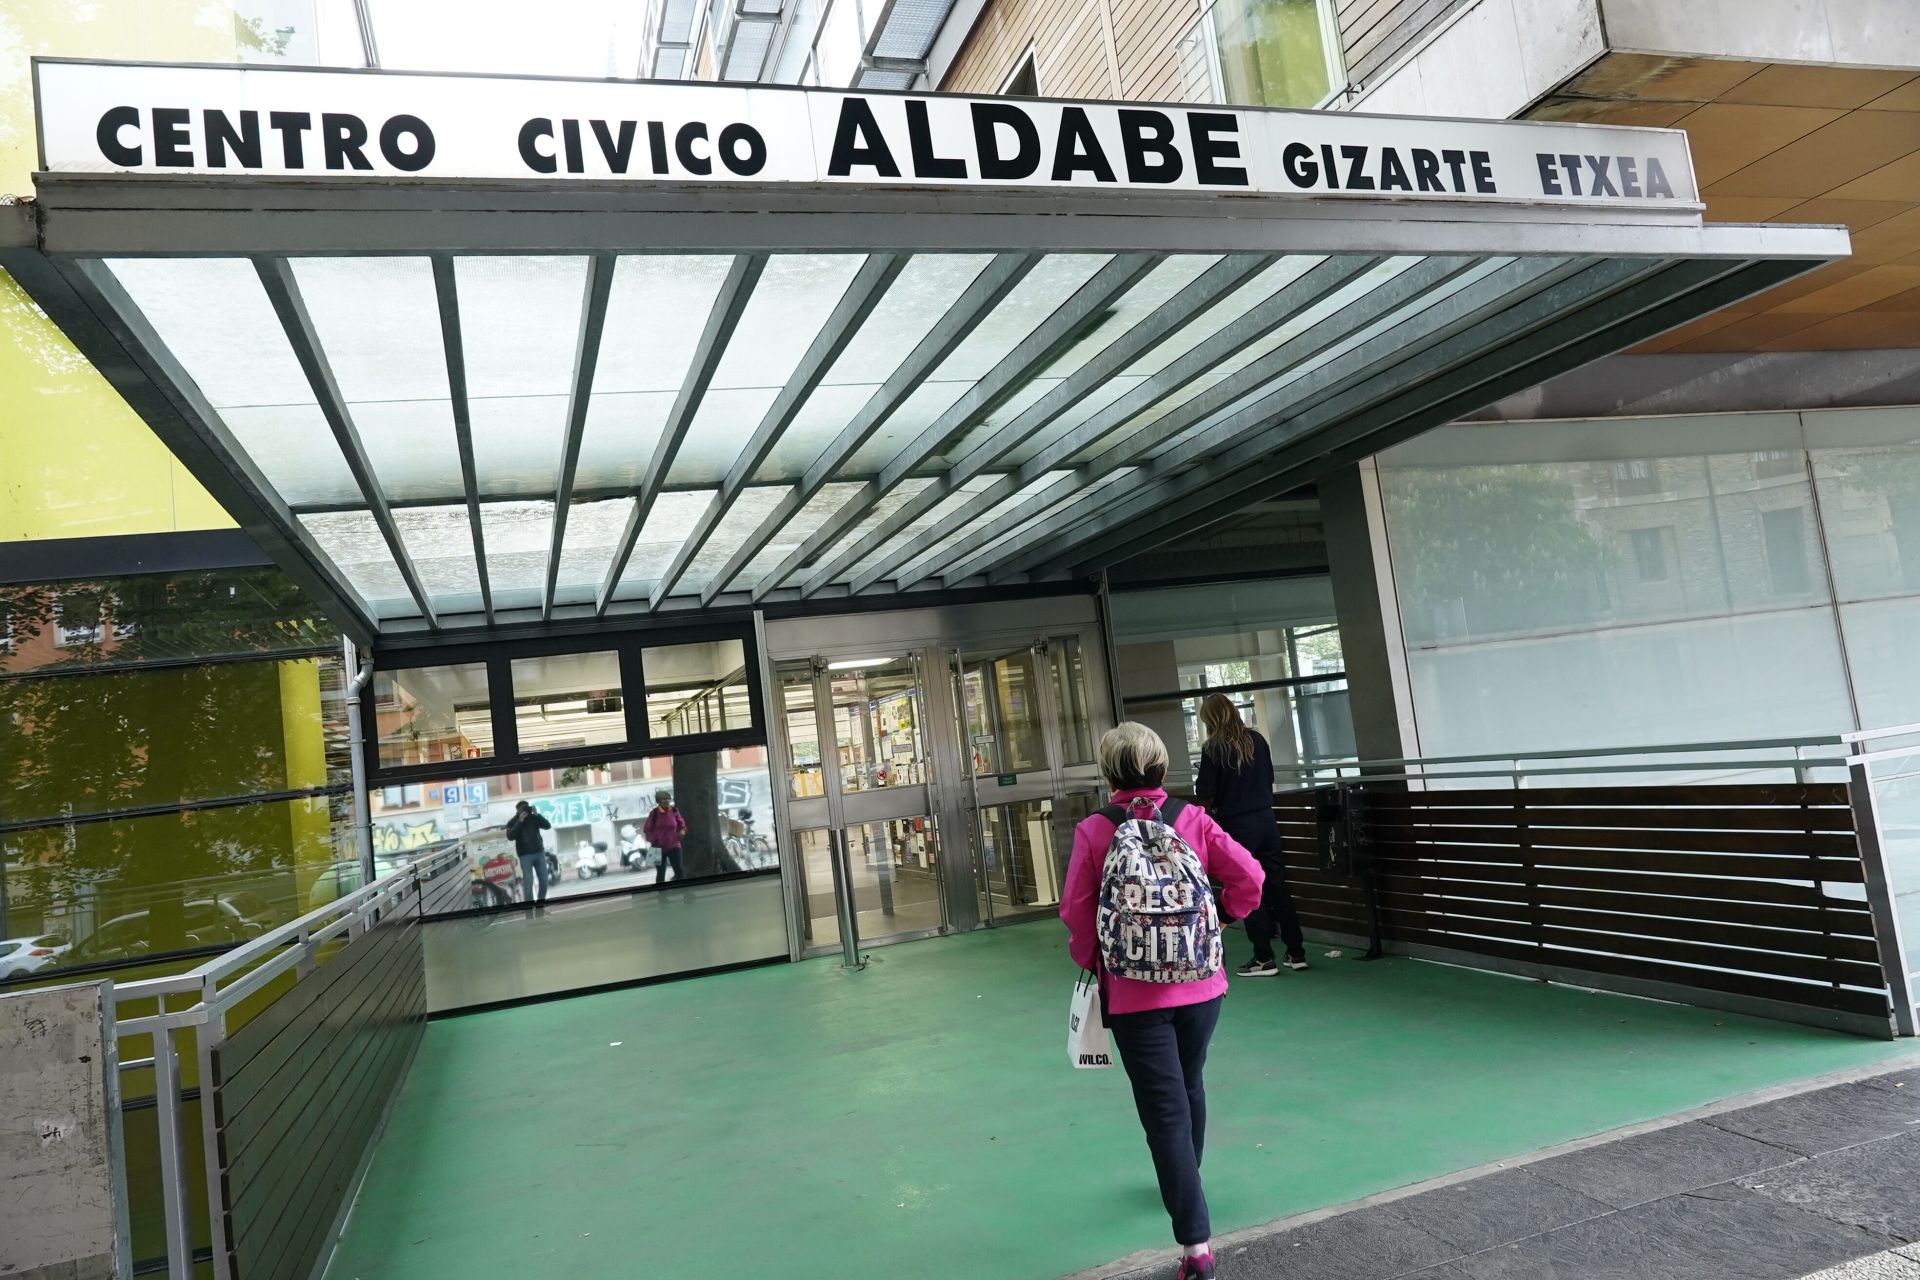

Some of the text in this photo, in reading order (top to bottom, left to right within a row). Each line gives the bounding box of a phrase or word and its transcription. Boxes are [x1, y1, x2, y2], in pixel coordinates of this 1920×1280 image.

[97, 97, 1675, 199] CENTRO CIVICO ALDABE GIZARTE ETXEA
[1126, 923, 1196, 963] CITY
[1079, 1053, 1112, 1066] WILCO.
